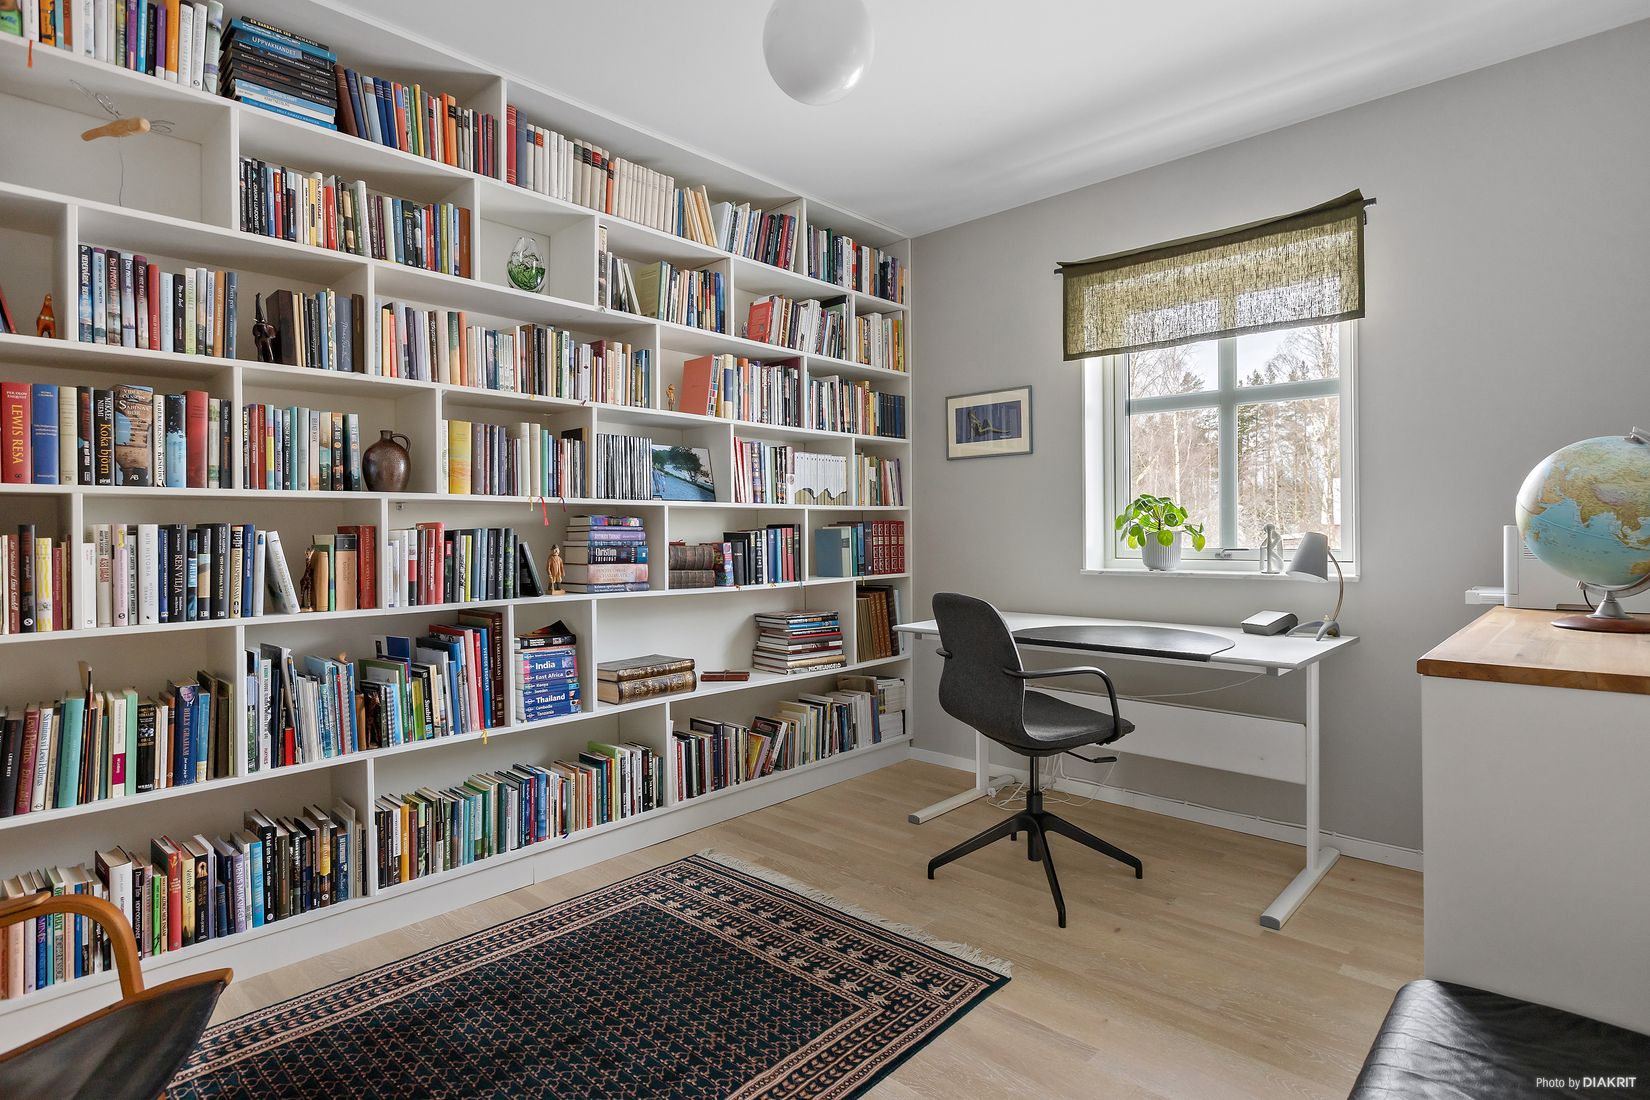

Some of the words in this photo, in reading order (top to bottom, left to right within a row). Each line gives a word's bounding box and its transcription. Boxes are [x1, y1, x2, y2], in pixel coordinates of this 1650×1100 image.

[252, 36, 296, 56] UPPVAKNANDET
[12, 404, 24, 436] LEWIS
[100, 424, 111, 446] Koka
[12, 439, 23, 464] RESA
[98, 449, 111, 474] björn
[596, 548, 617, 556] Christian
[174, 572, 182, 593] VILJA
[808, 663, 841, 671] MICHELANGELO
[536, 693, 565, 704] Thailand
[27, 715, 38, 733] Lewi
[23, 734, 37, 764] Pethrus
[39, 748, 48, 763] Lewi
[37, 764, 46, 786] Pethrus
[236, 885, 244, 922] MUKWEGE
